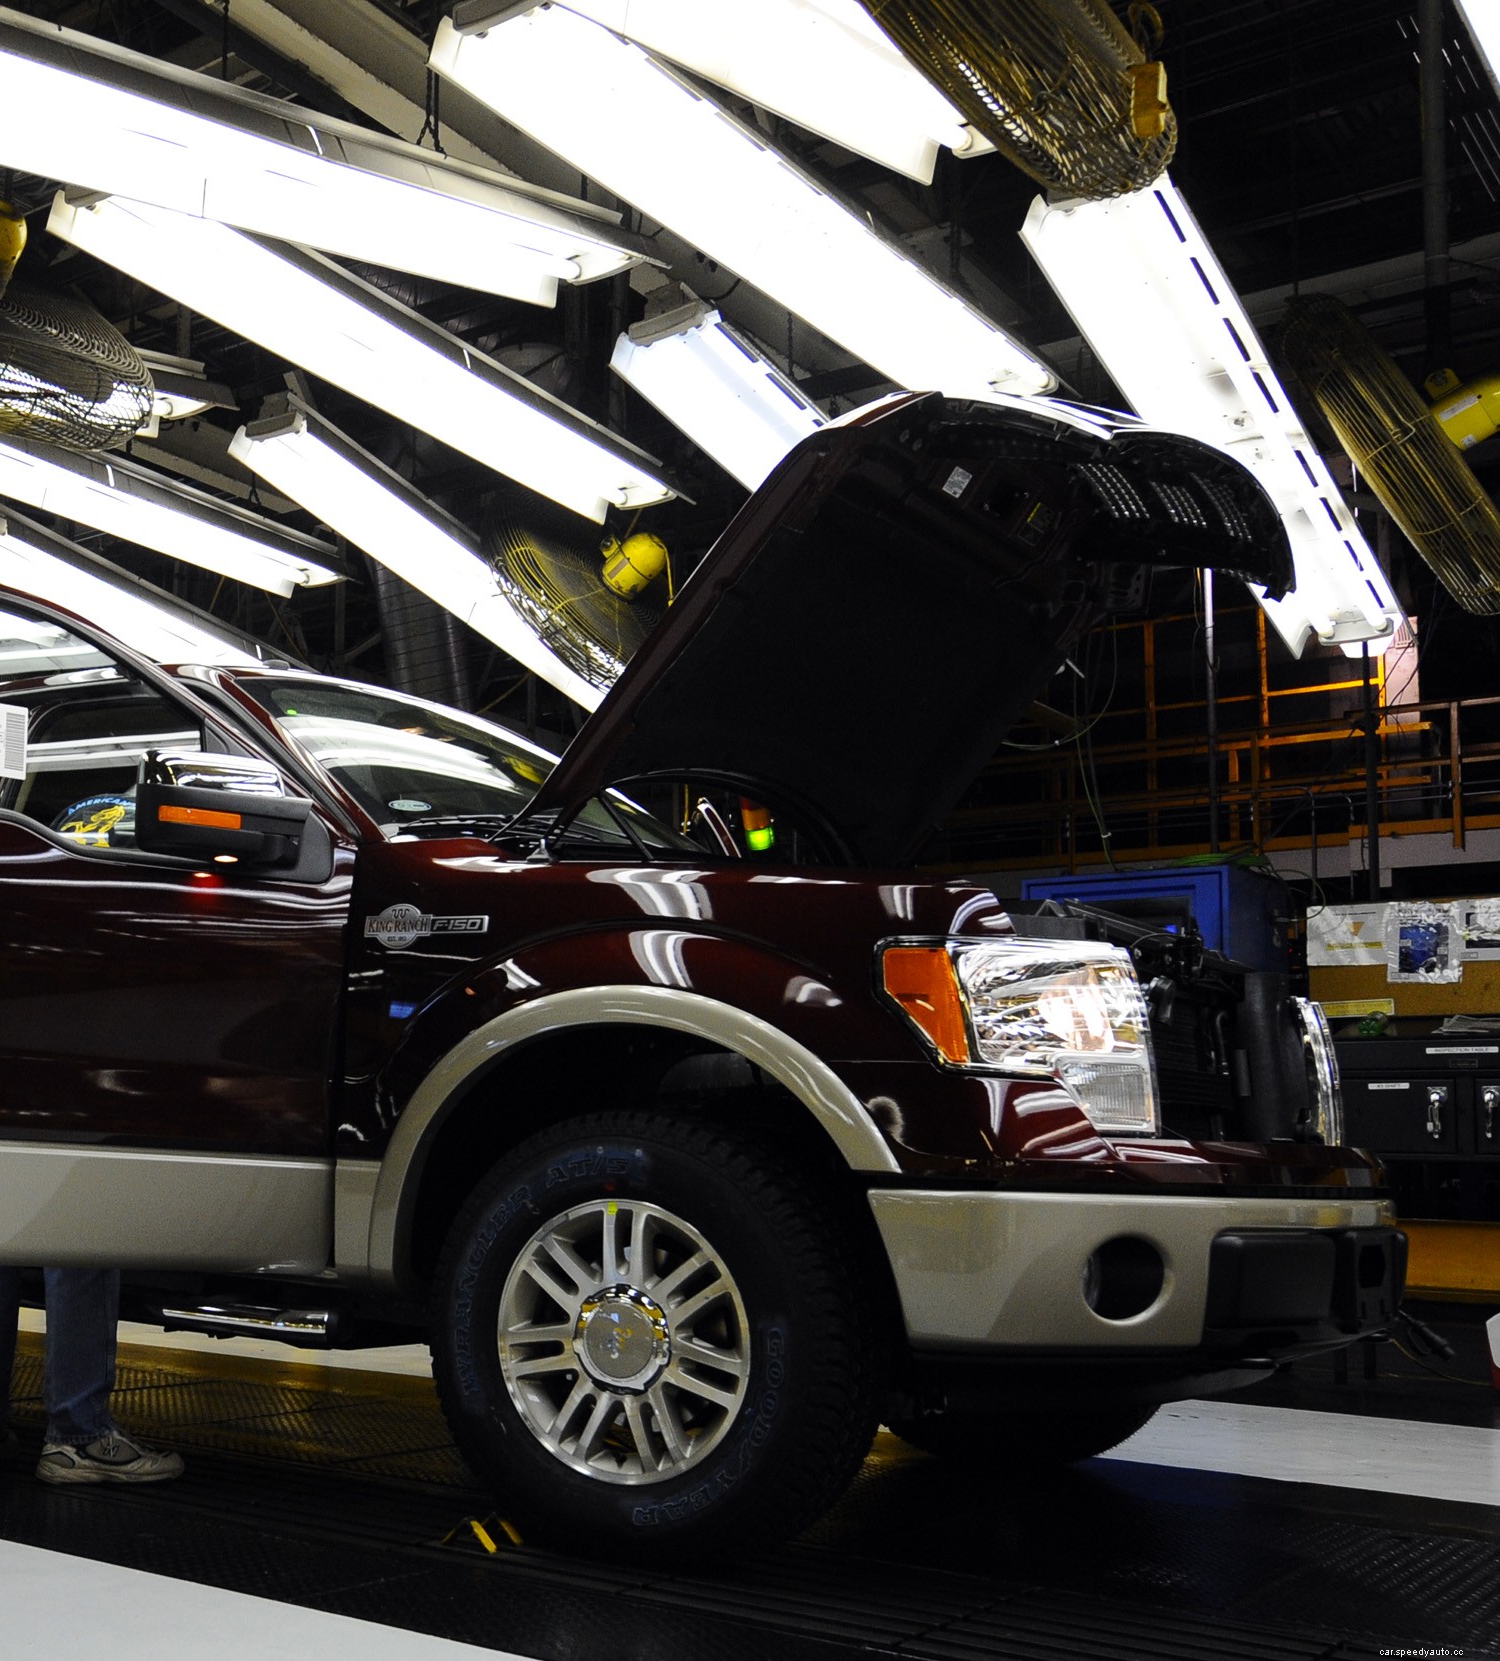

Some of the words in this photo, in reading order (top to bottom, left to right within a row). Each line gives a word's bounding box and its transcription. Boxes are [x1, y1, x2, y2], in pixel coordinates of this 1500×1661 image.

[368, 919, 394, 933] KING
[394, 917, 428, 933] RANCH
[432, 919, 481, 931] F-150
[453, 1184, 532, 1398] WRANGLER
